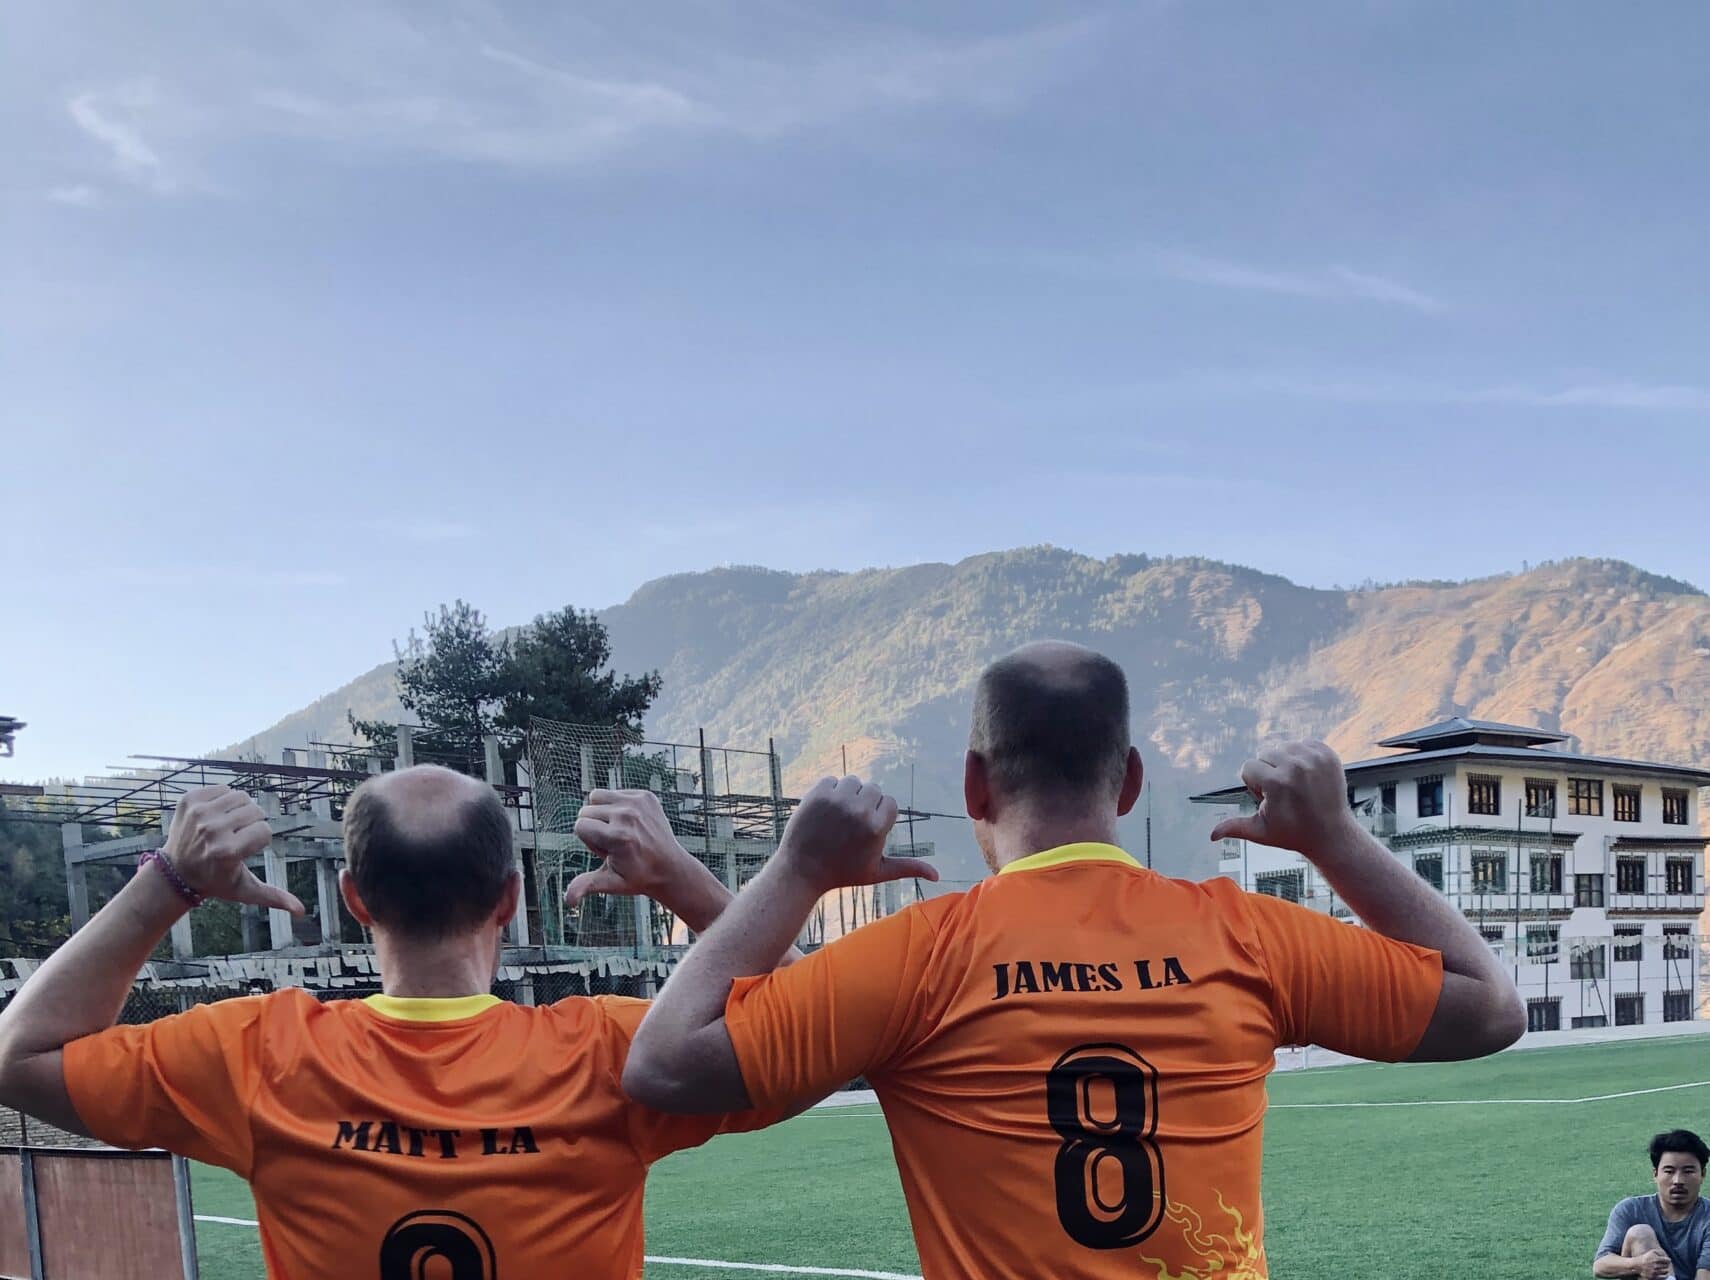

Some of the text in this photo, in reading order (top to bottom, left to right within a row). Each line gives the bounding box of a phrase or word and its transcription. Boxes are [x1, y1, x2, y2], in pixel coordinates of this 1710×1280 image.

[992, 956, 1192, 1001] JAMES LA
[331, 1121, 541, 1159] MATT LA
[1045, 1042, 1167, 1250] 8
